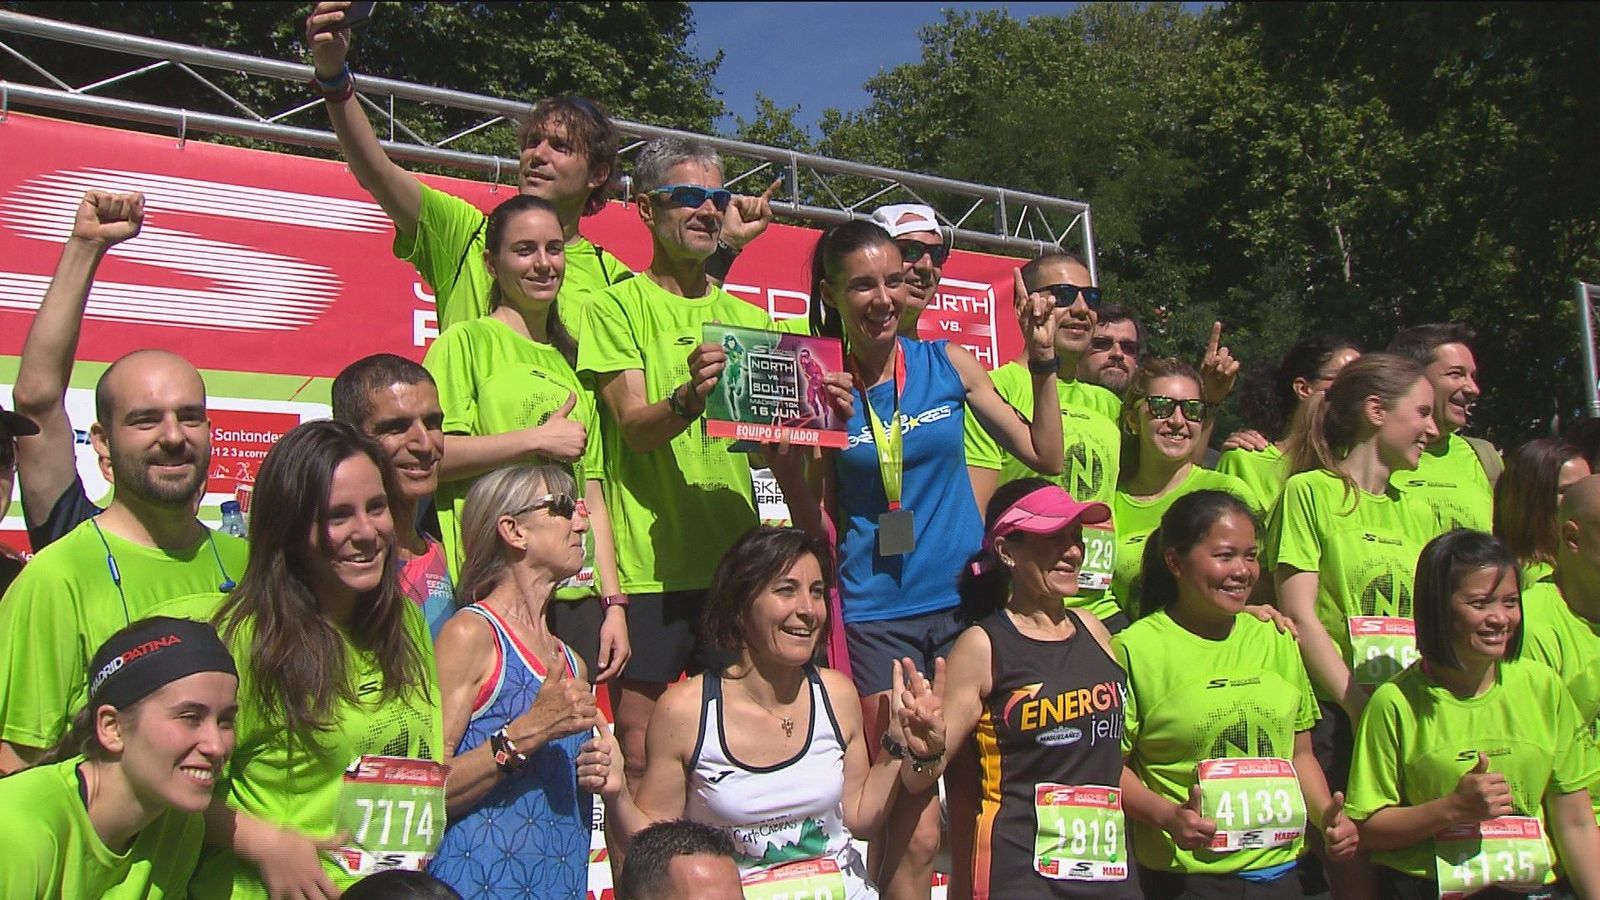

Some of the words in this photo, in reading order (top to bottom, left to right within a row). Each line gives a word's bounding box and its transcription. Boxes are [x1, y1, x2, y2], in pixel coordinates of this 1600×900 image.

[926, 292, 988, 315] ORTH
[751, 359, 794, 373] NORTH
[752, 382, 796, 396] SOUTH
[751, 406, 769, 416] 16
[771, 408, 800, 419] JUN
[736, 425, 772, 438] EQUIPO
[774, 428, 819, 442] GADOR
[1020, 681, 1119, 731] ENERGY
[1215, 788, 1293, 826] 4133
[354, 798, 434, 846] 7774
[1054, 817, 1118, 857] 1819
[1102, 866, 1125, 876] MARCA
[1452, 850, 1536, 887] 4135
